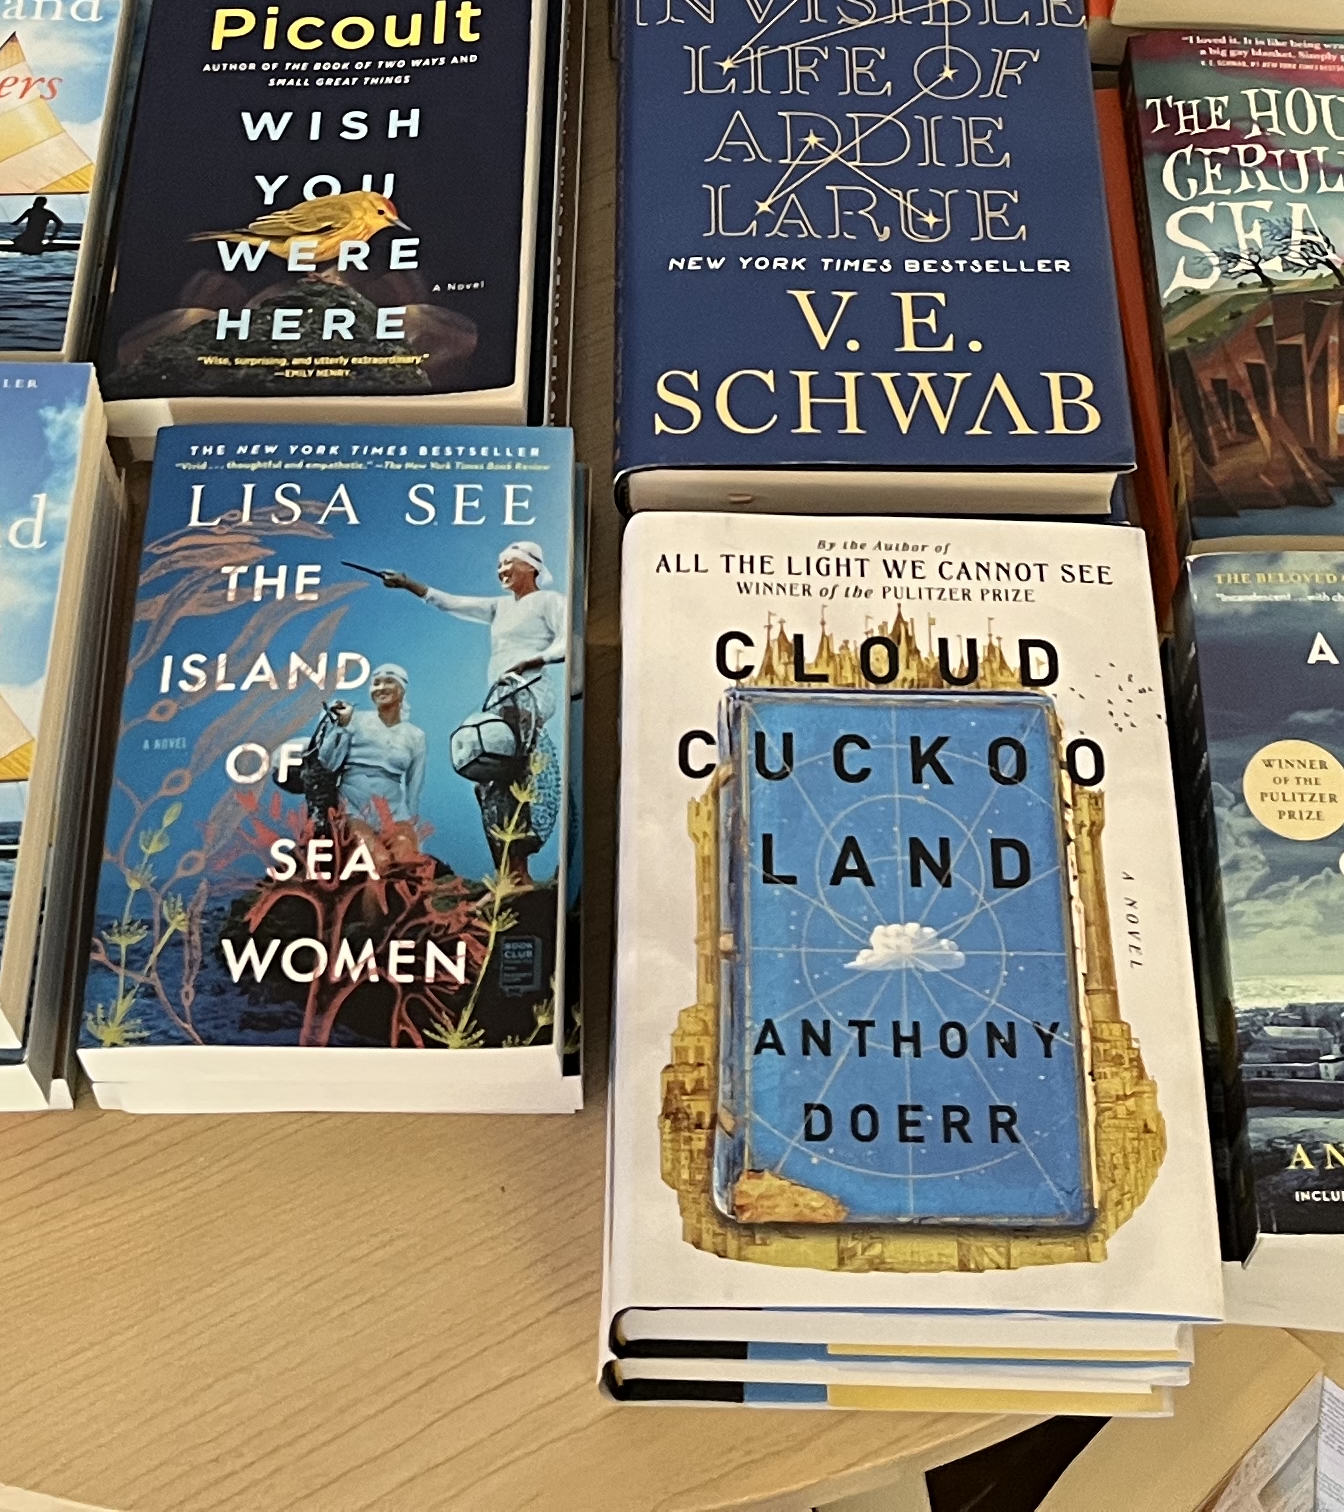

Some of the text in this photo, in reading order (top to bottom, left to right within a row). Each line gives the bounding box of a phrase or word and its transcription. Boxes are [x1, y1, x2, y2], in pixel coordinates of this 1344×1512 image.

[210, 0, 482, 51] Picoult
[683, 44, 1040, 100] LIFE OF
[240, 108, 421, 141] WISH
[1146, 94, 1231, 135] THE
[703, 110, 1011, 168] ADDIE
[254, 173, 395, 205] YOU
[702, 184, 1028, 243] LARUE
[216, 237, 420, 272] WERE
[215, 306, 408, 341] HERE
[787, 289, 983, 353] V. E.
[654, 369, 1102, 436] SCHWAB
[187, 483, 537, 527] LISA SEE
[219, 564, 322, 601] THE
[159, 653, 371, 693] ISLAND
[715, 630, 1060, 688] CLOUD
[224, 743, 308, 784] OF
[677, 730, 1106, 787] CUCKOO
[266, 839, 380, 881] SEA
[761, 833, 1032, 889] LAND
[221, 937, 467, 985] WOMEN
[754, 1018, 1062, 1059] ANTHONY
[803, 1103, 1021, 1145] DOERR
